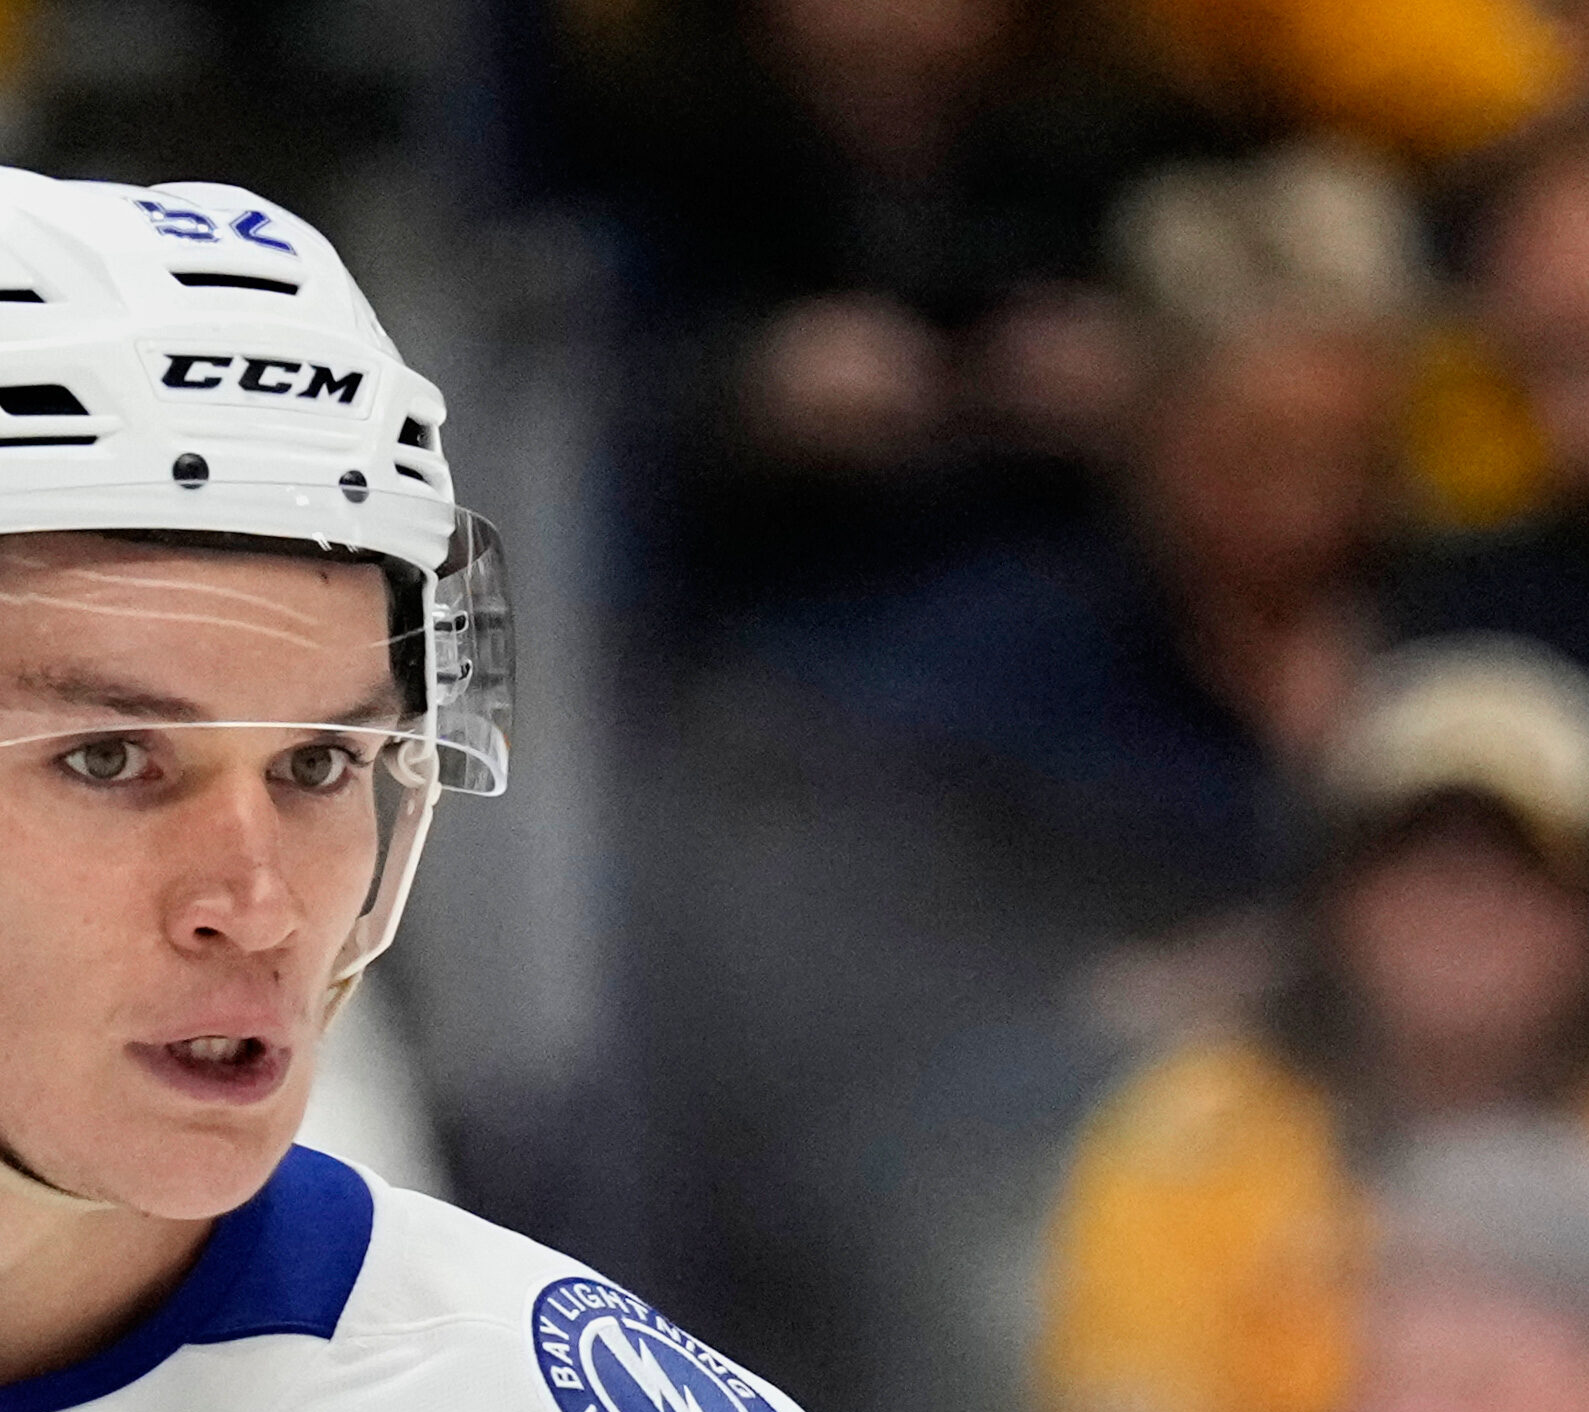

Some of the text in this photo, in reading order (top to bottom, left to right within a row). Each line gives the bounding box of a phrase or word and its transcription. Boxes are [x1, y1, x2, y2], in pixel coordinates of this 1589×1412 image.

[161, 354, 364, 404] CCM
[539, 1314, 585, 1391] BAY
[546, 1282, 756, 1400] LIGHTNING
